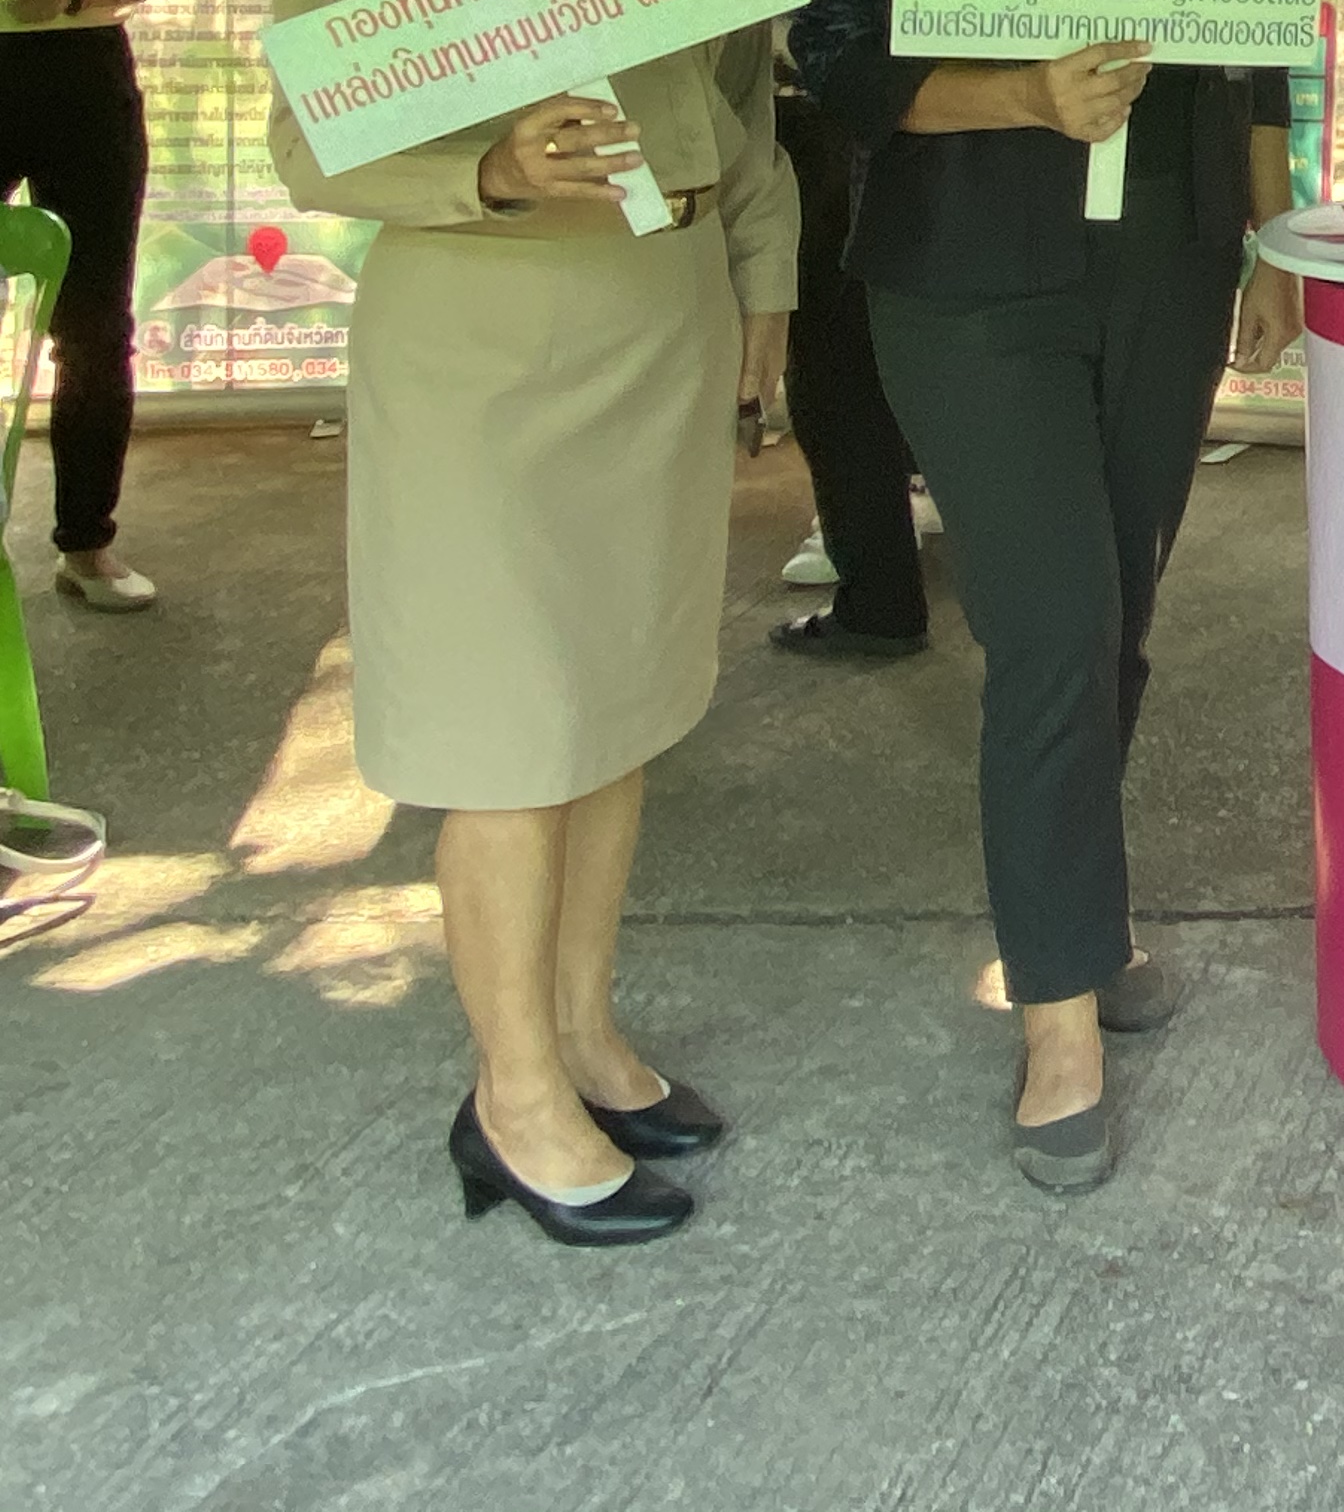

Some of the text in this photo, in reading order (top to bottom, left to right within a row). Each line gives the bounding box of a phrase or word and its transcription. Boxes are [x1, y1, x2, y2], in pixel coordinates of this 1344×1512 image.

[900, 2, 1315, 49] ส่งเสริมพัฒนาคุณภาพชีวิตของสตรี
